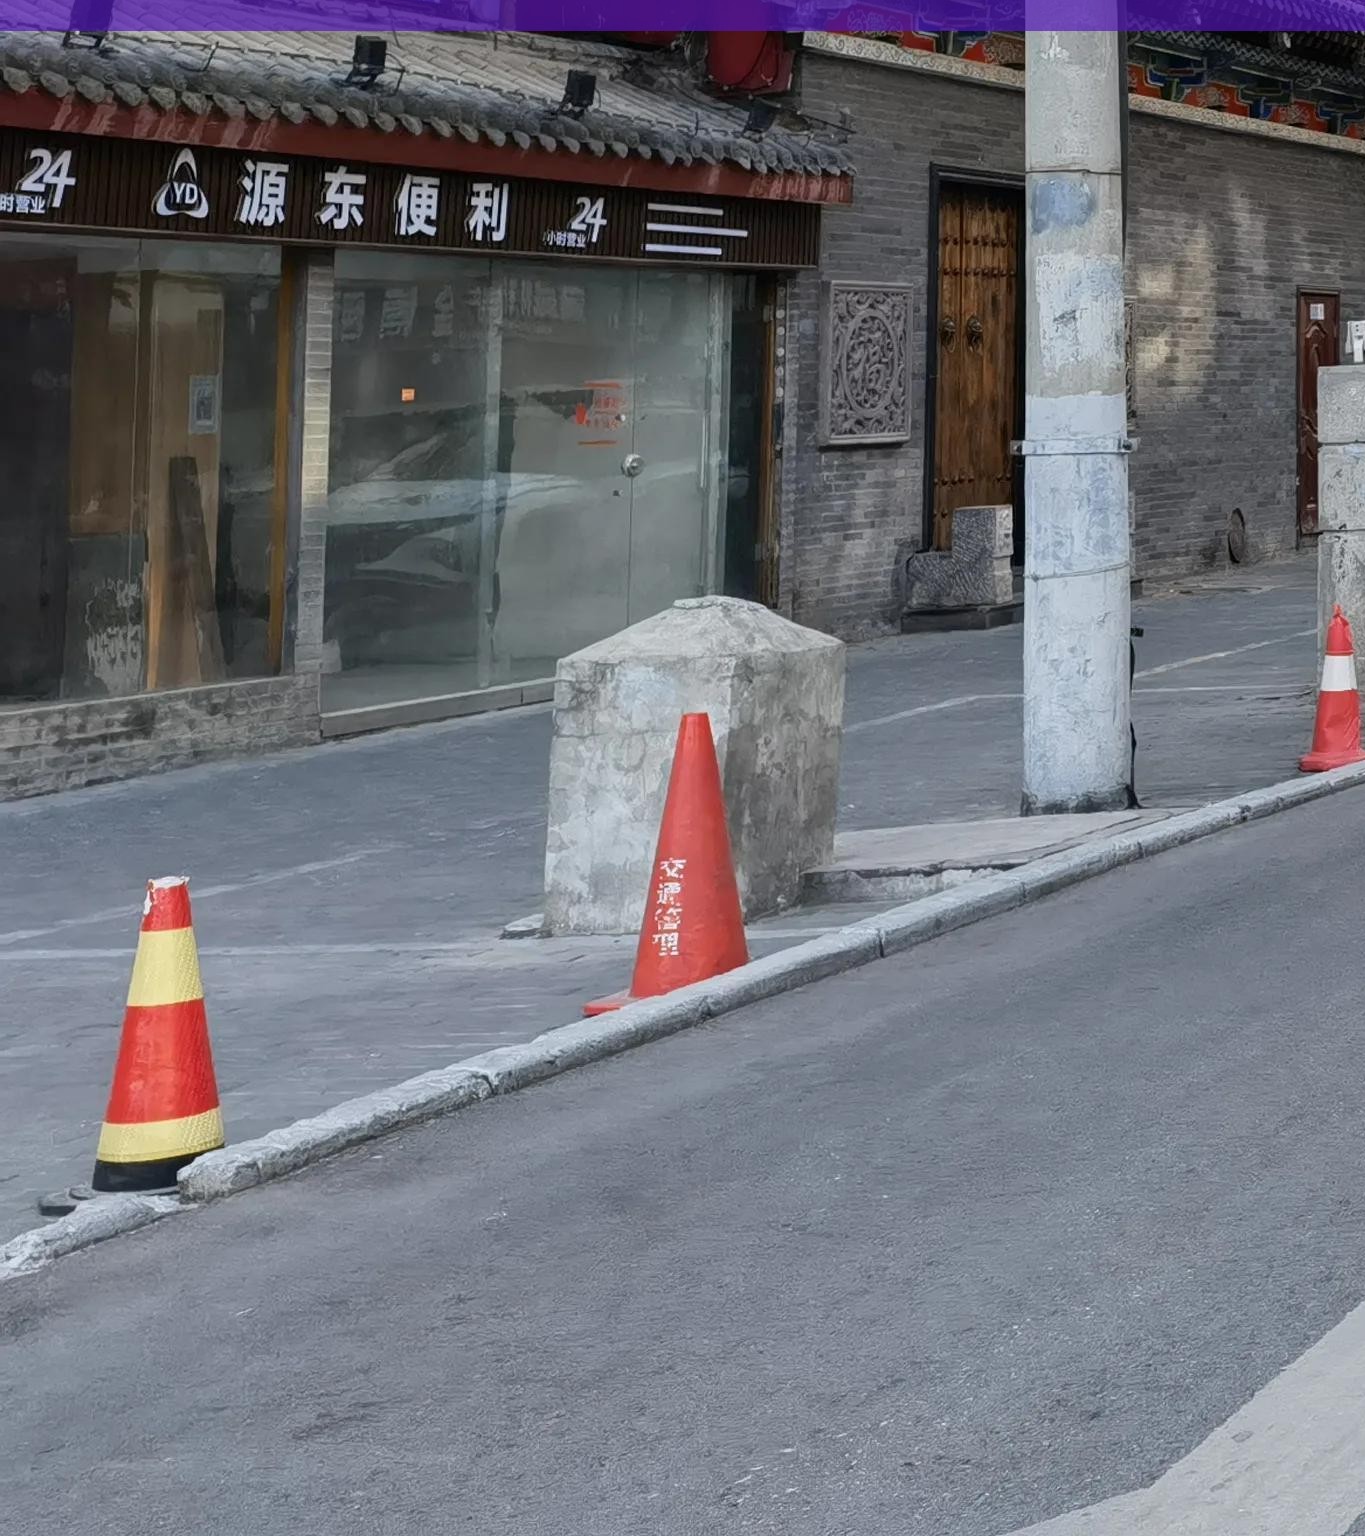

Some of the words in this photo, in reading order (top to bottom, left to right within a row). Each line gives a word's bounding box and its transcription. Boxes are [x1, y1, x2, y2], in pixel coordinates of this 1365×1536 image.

[21, 148, 76, 208] 24
[173, 182, 199, 205] YD
[237, 158, 511, 241] 源东便利
[546, 228, 587, 248] 小时营业
[571, 196, 608, 243] 24
